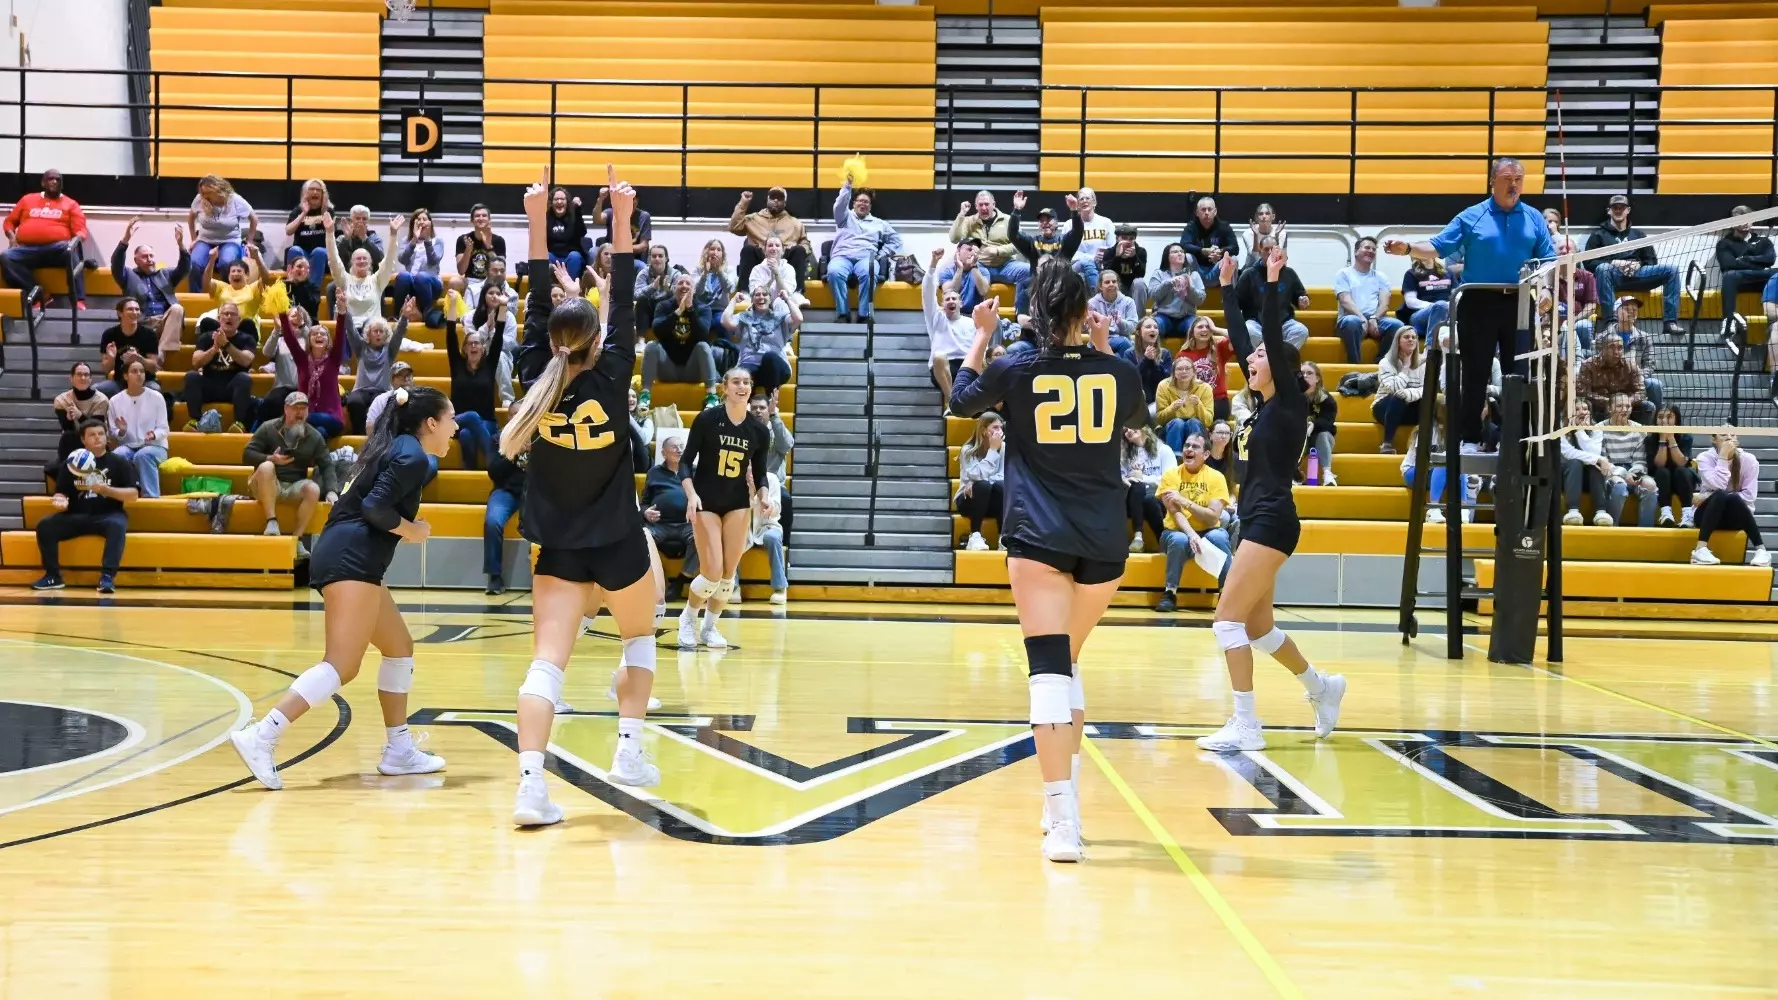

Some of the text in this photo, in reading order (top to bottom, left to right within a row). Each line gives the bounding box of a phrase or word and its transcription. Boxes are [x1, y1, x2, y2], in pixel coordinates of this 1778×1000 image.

[407, 116, 438, 152] D
[1083, 229, 1106, 241] ILLE
[1032, 373, 1117, 444] 20
[719, 435, 749, 450] VILLE
[717, 449, 745, 478] 15
